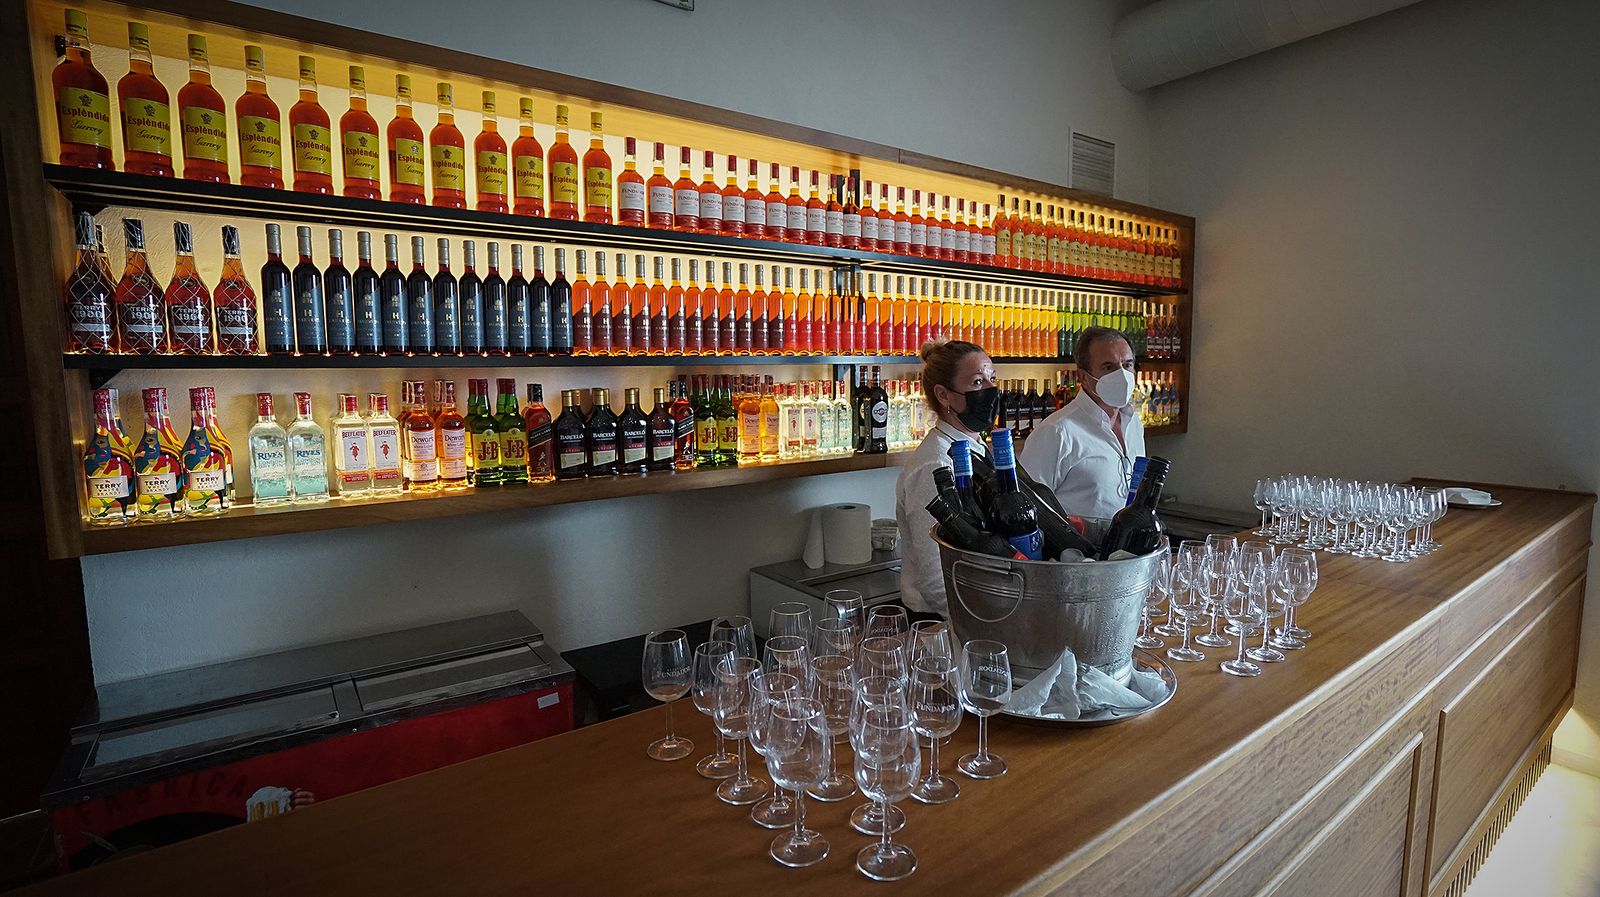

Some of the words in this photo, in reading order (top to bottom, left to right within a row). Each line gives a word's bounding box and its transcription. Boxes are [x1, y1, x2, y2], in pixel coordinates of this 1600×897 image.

[296, 450, 320, 458] RIVES
[478, 441, 498, 460] J&B
[504, 440, 525, 458] J&B
[257, 452, 283, 460] RIVES
